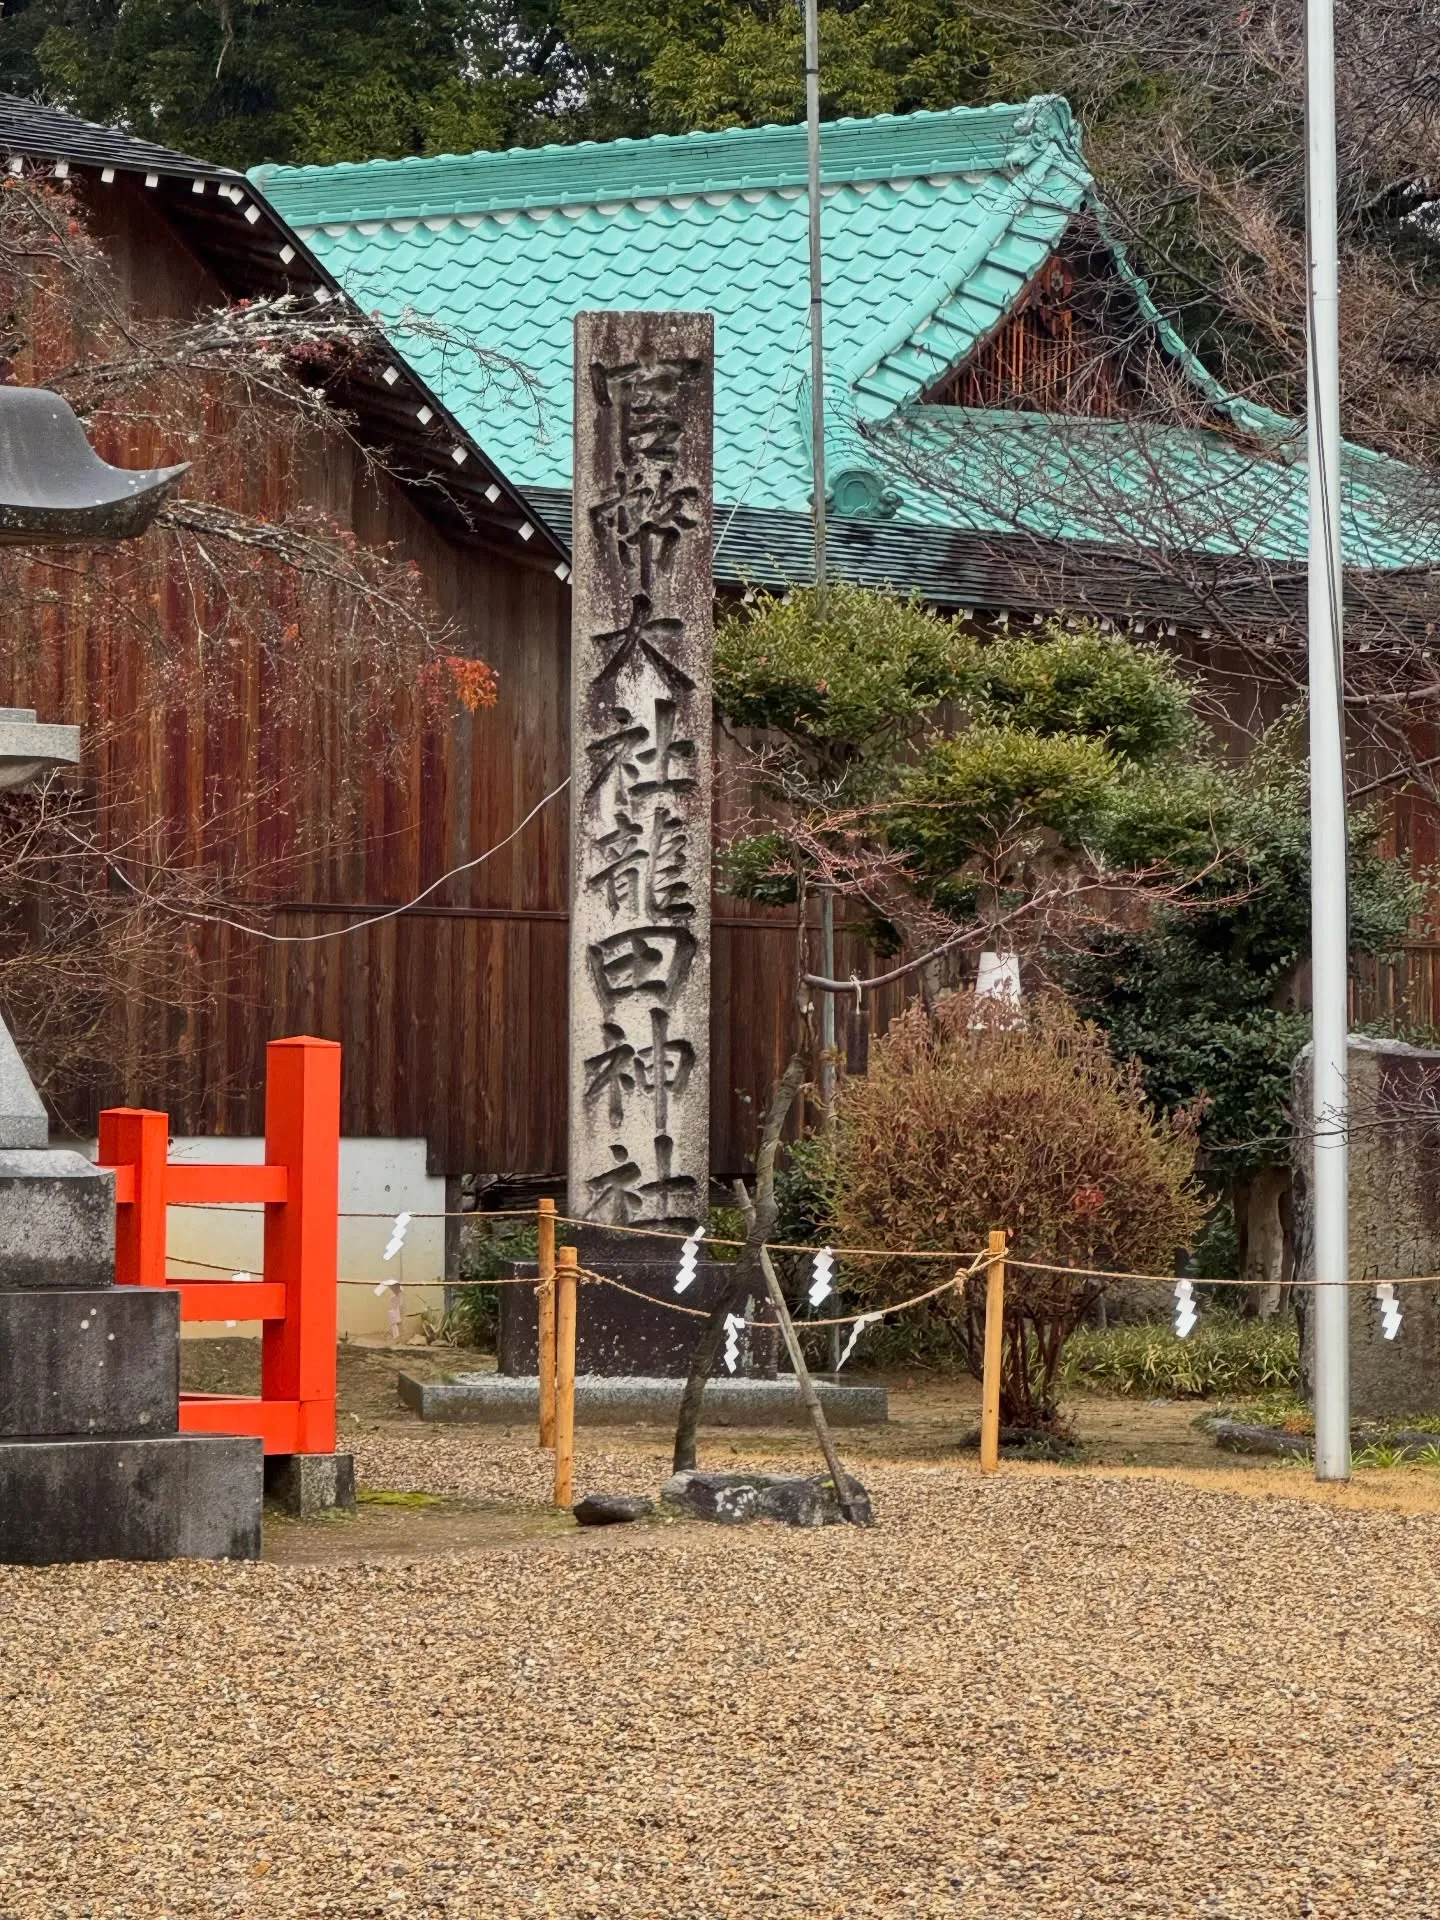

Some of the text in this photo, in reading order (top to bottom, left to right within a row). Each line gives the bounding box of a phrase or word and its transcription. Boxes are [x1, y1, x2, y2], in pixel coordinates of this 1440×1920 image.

[583, 354, 703, 1229] 官幣大社龍田神社
